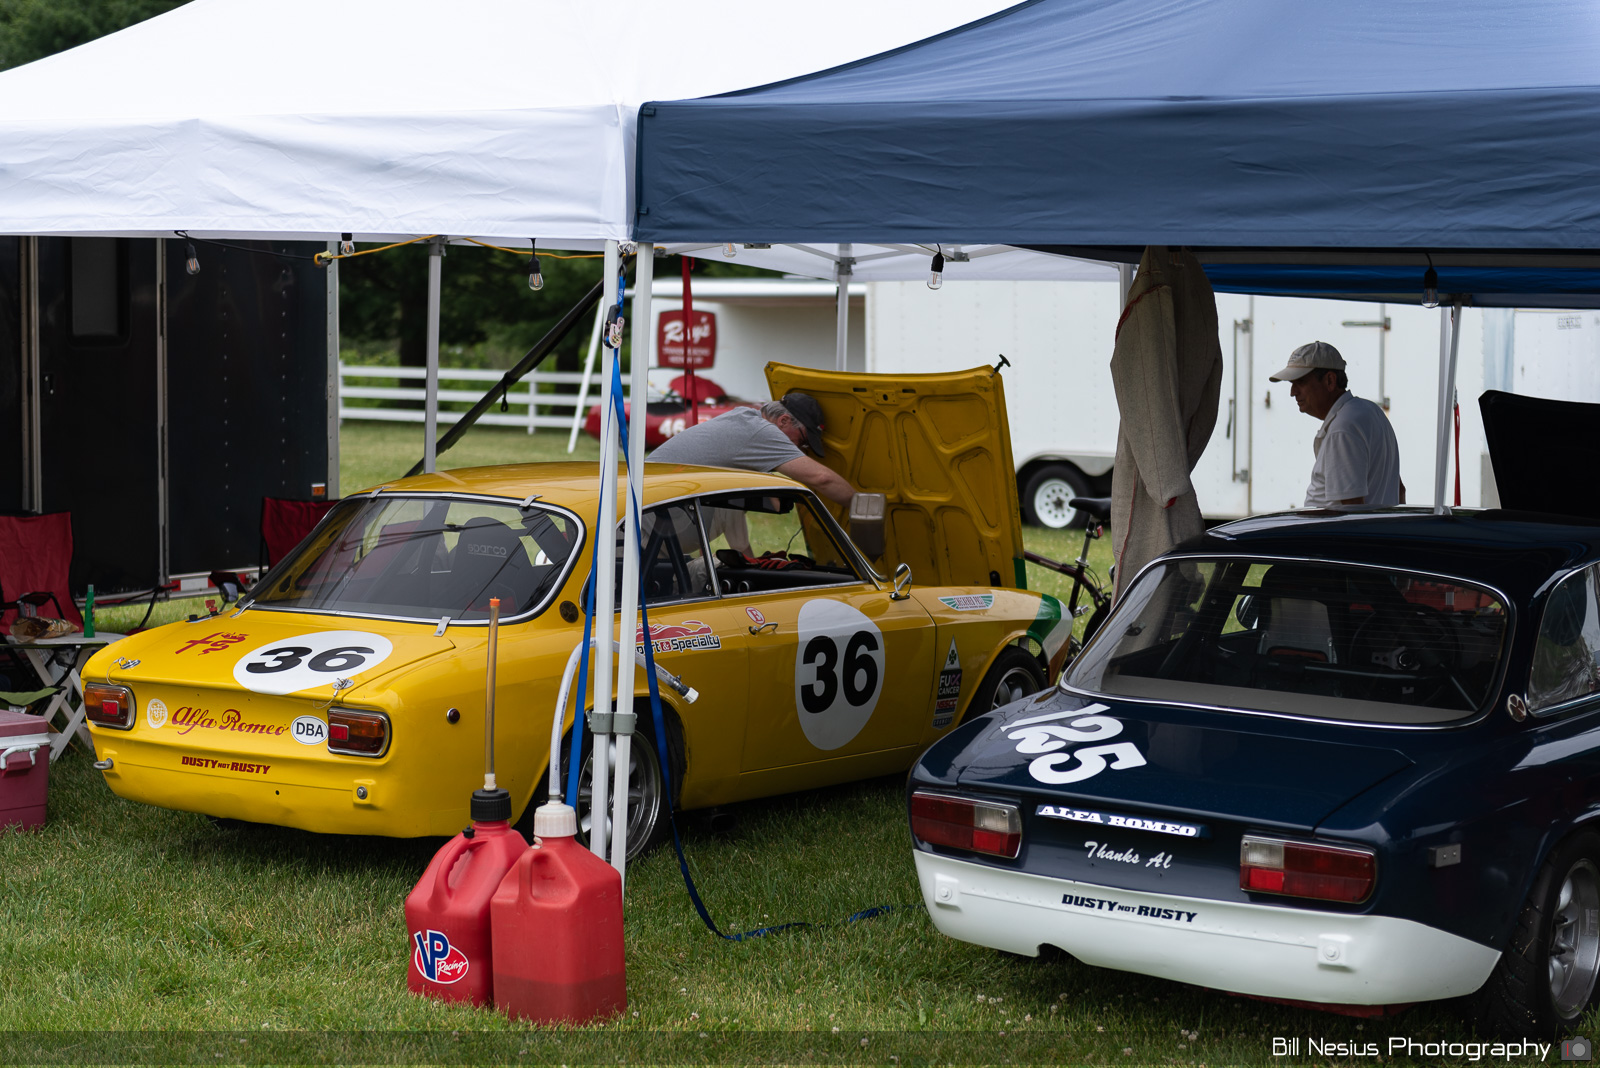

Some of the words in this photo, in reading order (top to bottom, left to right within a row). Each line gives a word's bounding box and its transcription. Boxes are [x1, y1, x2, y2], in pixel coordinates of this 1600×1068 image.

[659, 418, 685, 438] 46
[467, 543, 507, 556] sparco
[671, 634, 720, 652] Specialty
[246, 646, 375, 674] 36
[801, 630, 879, 714] 36
[938, 685, 960, 696] CANCER
[171, 706, 218, 735] Alfa
[219, 708, 290, 736] Romeo
[296, 722, 324, 738] DBA
[1000, 703, 1147, 784] 125
[181, 756, 218, 769] DUSTY
[230, 762, 271, 774] RUSTY
[1038, 806, 1104, 823] ALFA
[1107, 815, 1197, 836] ROMEO
[1084, 841, 1140, 864] Thanks
[1145, 852, 1173, 869] Al
[1061, 894, 1118, 912] DUSTY
[1117, 905, 1137, 913] NOT
[1137, 905, 1198, 923] RUSTY
[414, 930, 450, 981] VP
[438, 960, 468, 976] Racing
